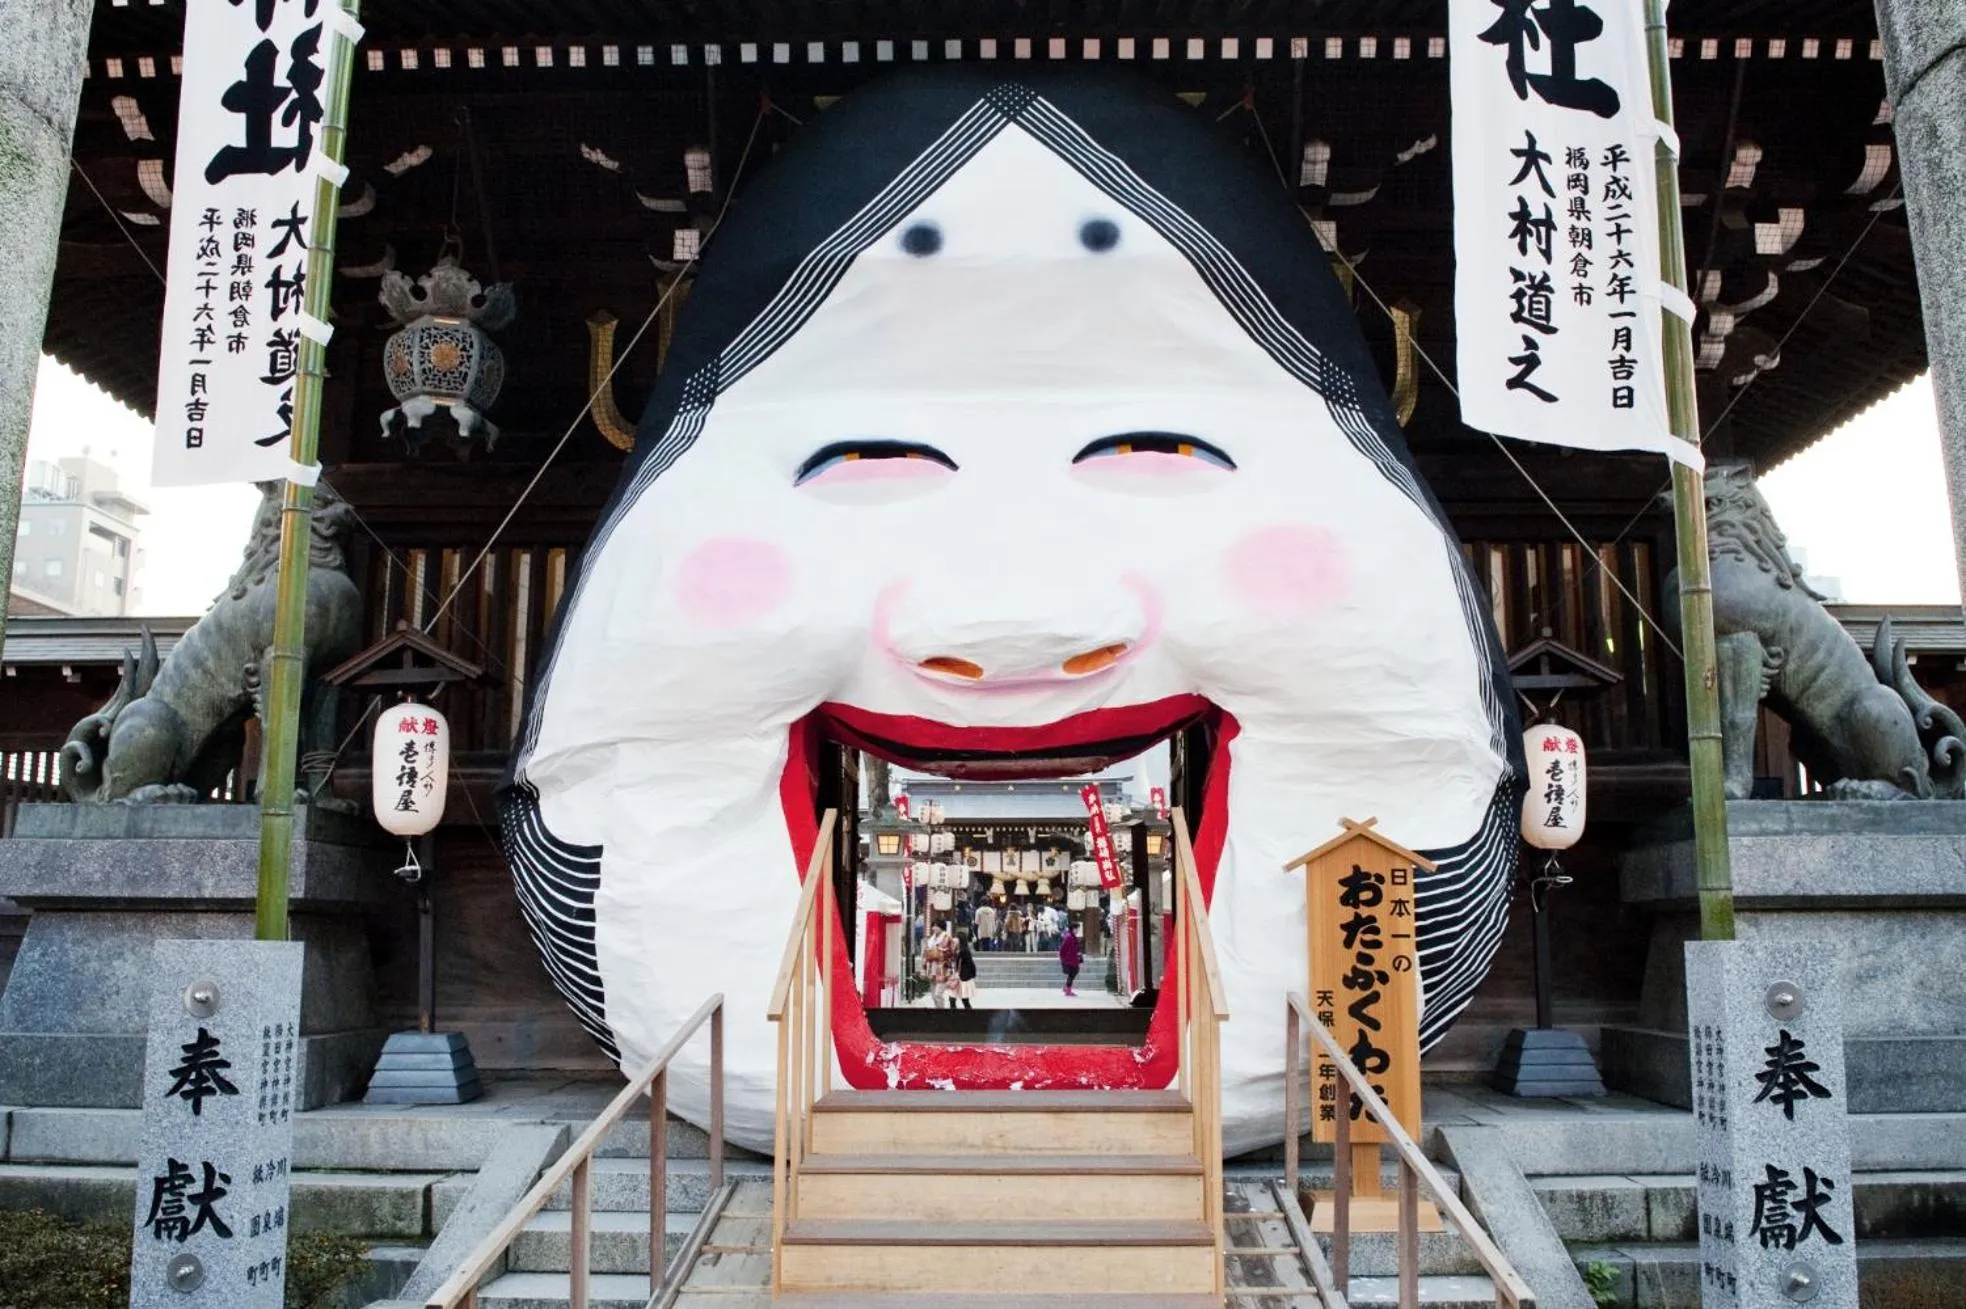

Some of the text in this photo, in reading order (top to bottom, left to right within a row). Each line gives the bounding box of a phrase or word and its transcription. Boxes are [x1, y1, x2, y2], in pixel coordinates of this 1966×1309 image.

[1505, 129, 1559, 404] 大村道之
[1565, 145, 1595, 307] 福岡県朝倉市
[1600, 143, 1638, 410] 平成二十六年一月吉日
[1389, 868, 1412, 973] 日本一の
[1316, 990, 1336, 1122] 天保一年創業
